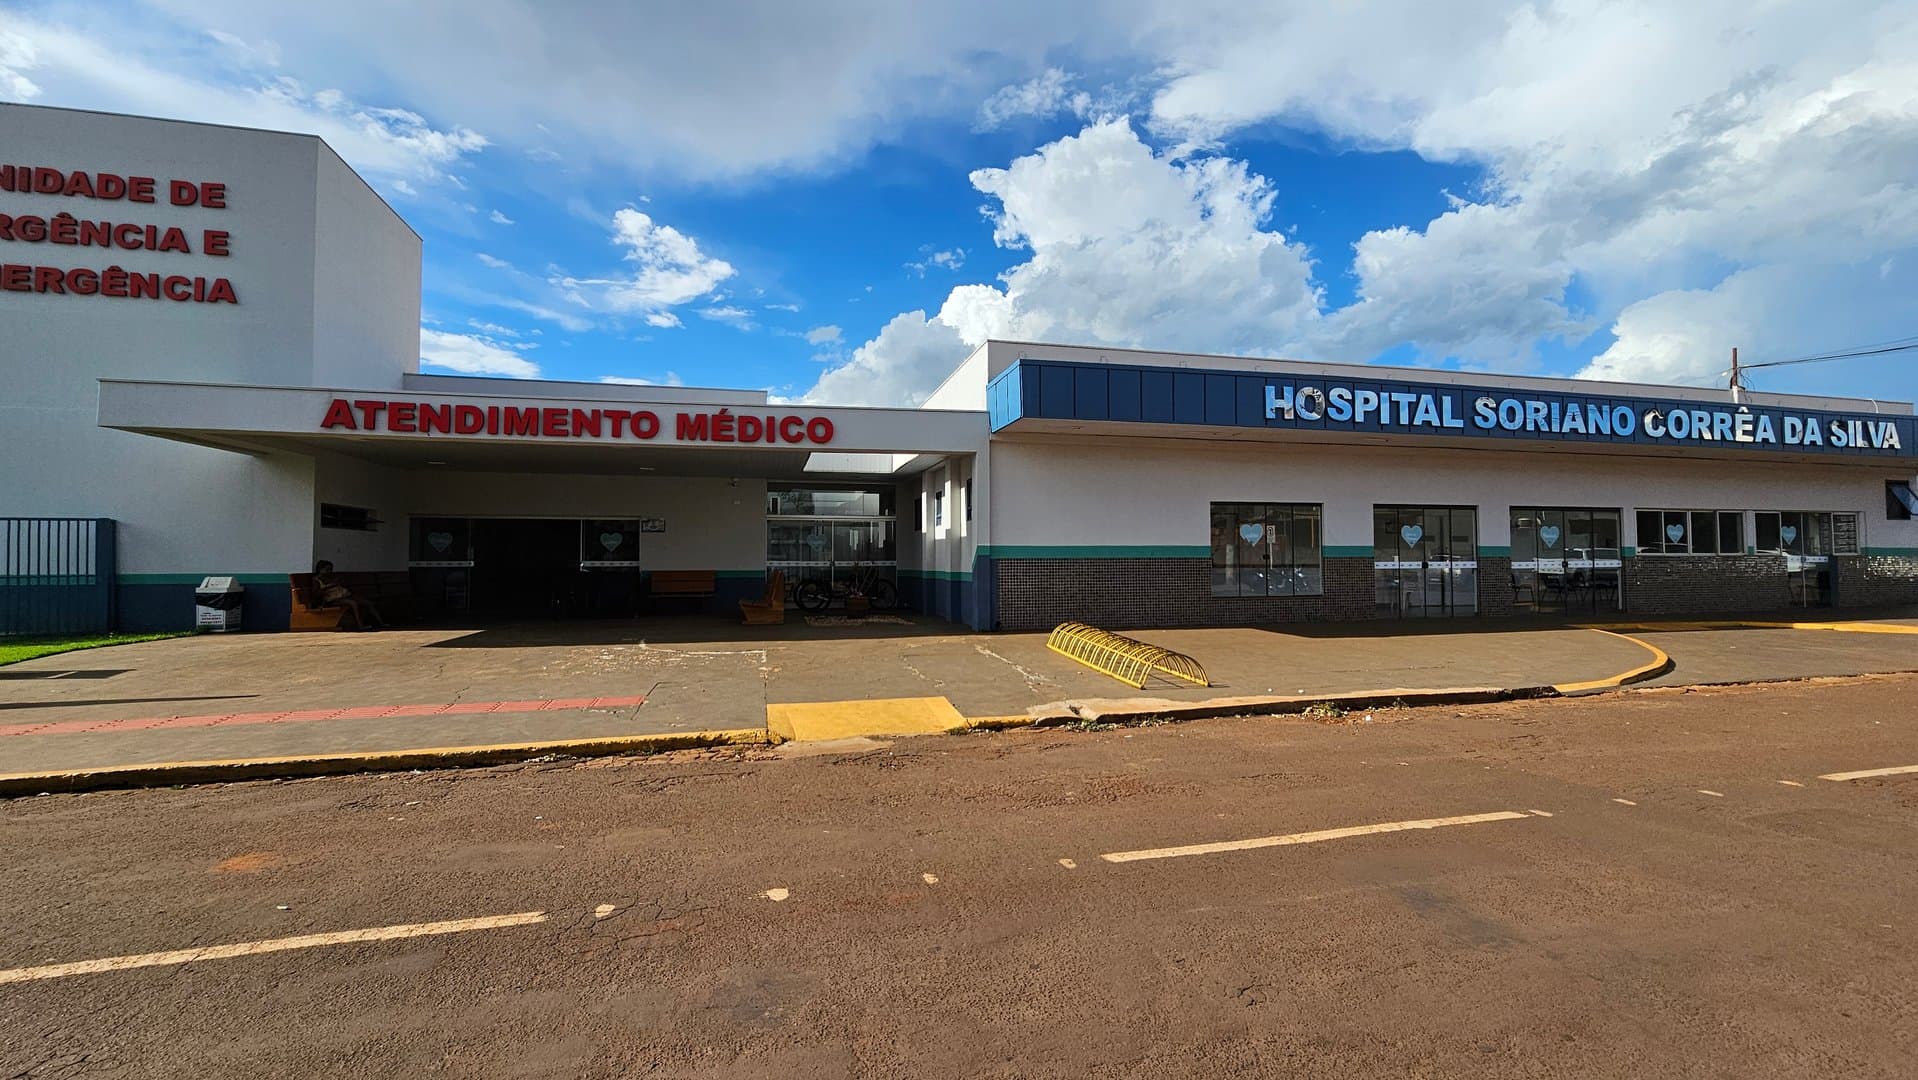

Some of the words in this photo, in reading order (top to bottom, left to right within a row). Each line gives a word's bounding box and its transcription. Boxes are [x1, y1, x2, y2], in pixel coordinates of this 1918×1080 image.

[170, 180, 226, 208] DE
[204, 230, 230, 256] E
[0, 263, 237, 304] ERGÊNCIA
[321, 398, 661, 440] ATENDIMENTO
[676, 408, 835, 444] MÉDICO
[1264, 385, 1464, 428] HOSPITAL
[1473, 396, 1636, 436] SORIANO
[1643, 406, 1777, 443] CORRÊA
[1783, 416, 1824, 446] DA
[1829, 419, 1902, 449] SILVA
